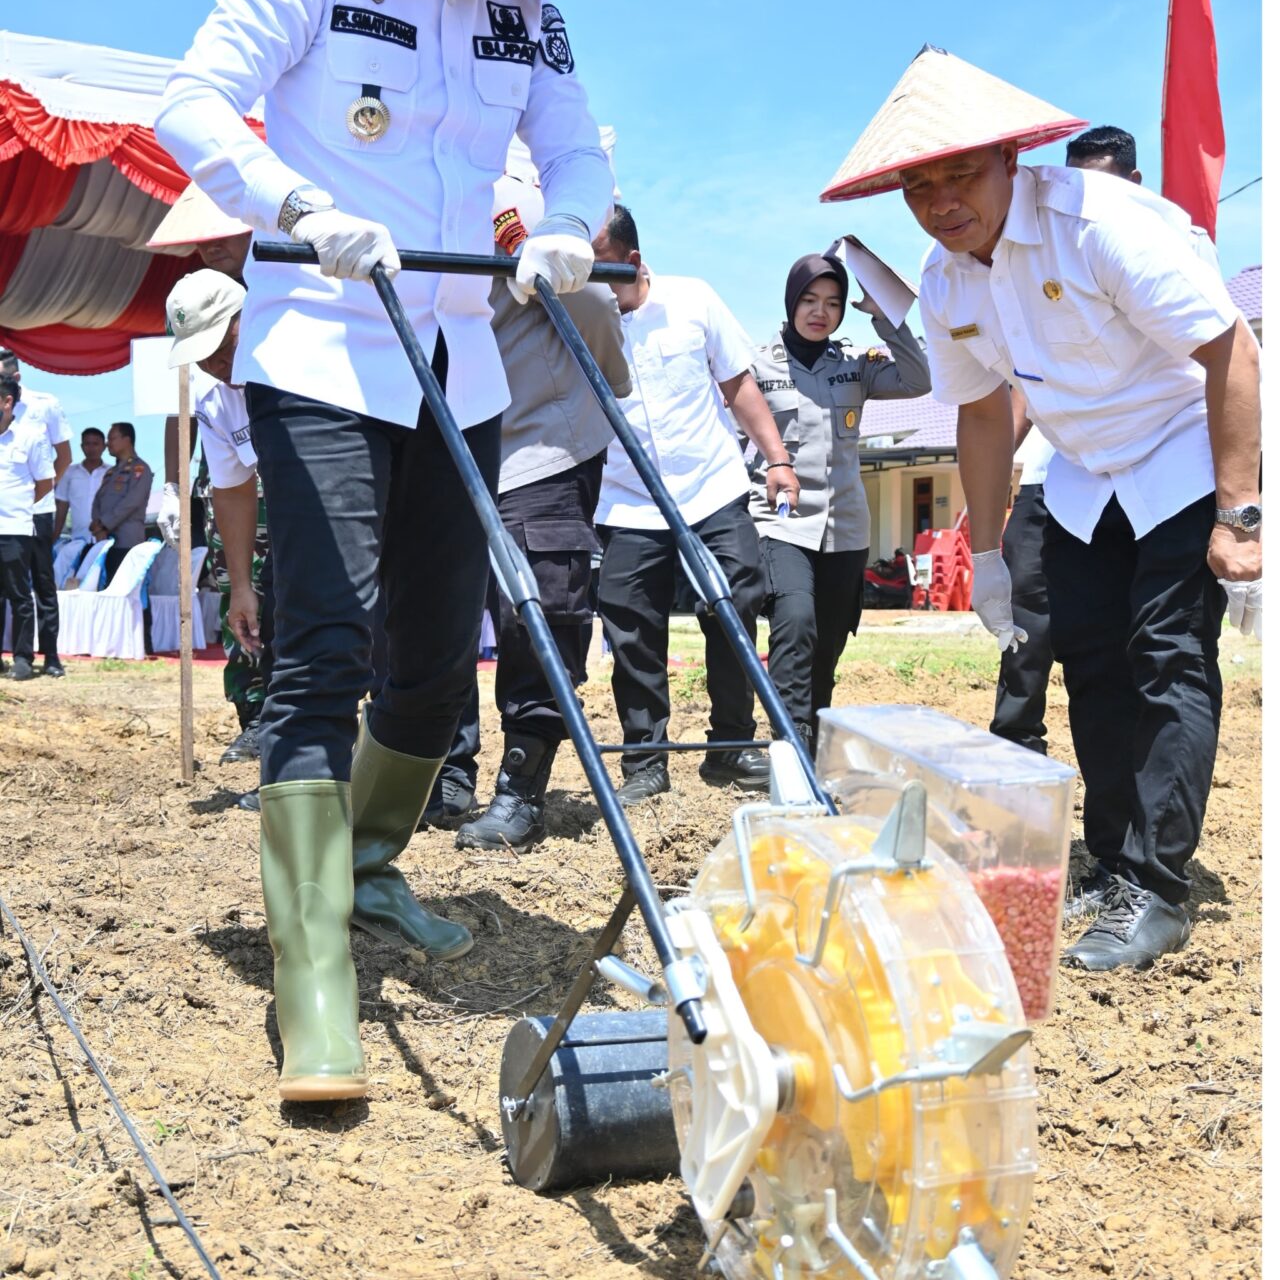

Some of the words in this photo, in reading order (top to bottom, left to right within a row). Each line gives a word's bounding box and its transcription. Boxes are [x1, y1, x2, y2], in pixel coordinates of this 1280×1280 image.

[480, 40, 536, 63] BUPAT
[828, 371, 861, 386] POLRI
[758, 379, 796, 394] MIFTAH
